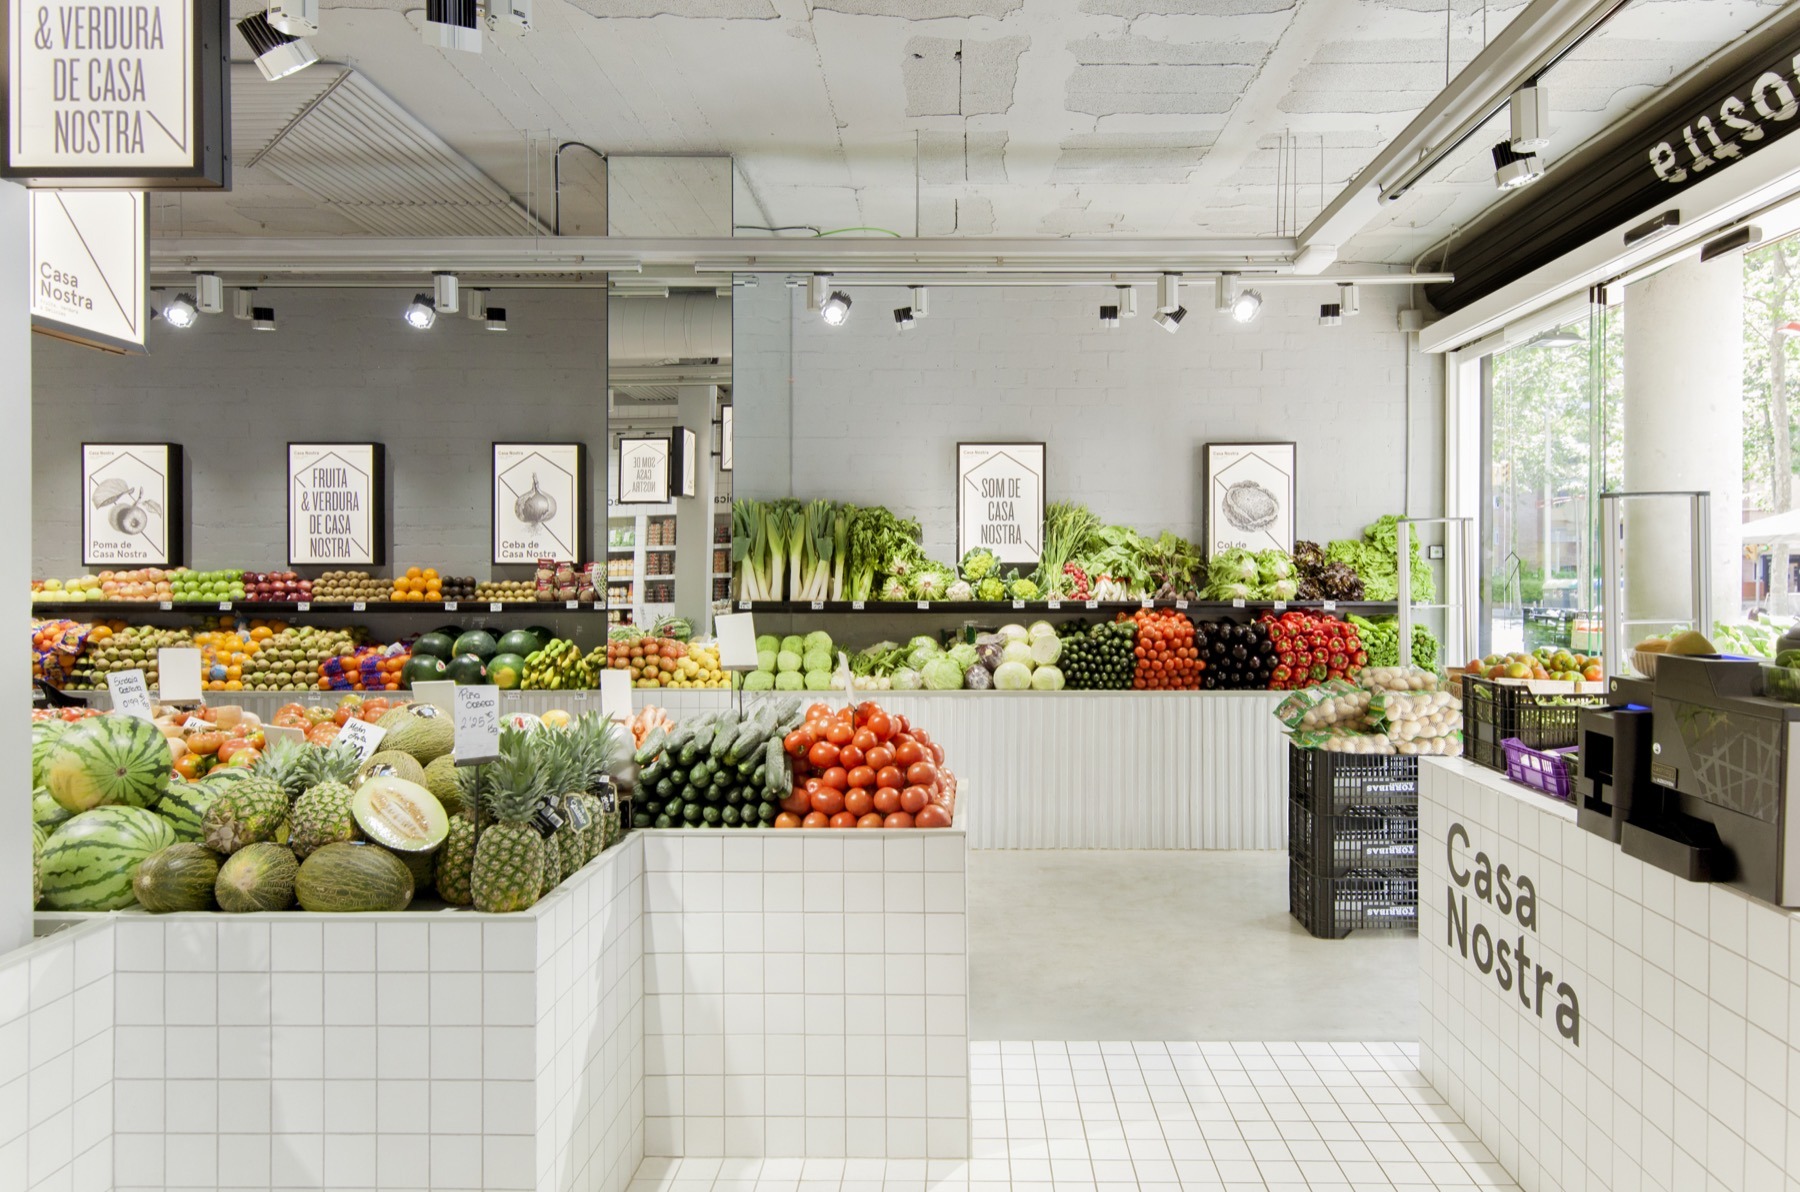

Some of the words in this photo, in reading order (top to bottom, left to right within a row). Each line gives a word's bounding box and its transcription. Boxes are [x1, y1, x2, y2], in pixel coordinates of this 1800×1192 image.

[35, 6, 53, 50] &
[59, 6, 164, 50] VERDURA
[53, 58, 80, 101] DE
[88, 58, 146, 101] CASA
[1649, 54, 1800, 183] ostra
[55, 110, 145, 153] NOSTRA
[40, 262, 78, 288] Casa
[40, 279, 93, 310] Nostra
[313, 468, 348, 488] FRUITA
[981, 478, 1005, 498] SOM
[1008, 478, 1021, 498] DE
[301, 491, 310, 511] &
[312, 491, 360, 511] VERDURA
[988, 501, 1015, 521] CASA
[309, 514, 322, 534] DE
[325, 514, 351, 534] CASA
[981, 524, 1022, 544] NOSTRA
[93, 541, 118, 549] Poma
[120, 541, 132, 549] de
[93, 550, 115, 558] Casa
[117, 550, 147, 558] Nostra
[310, 538, 351, 557] NOSTRA
[502, 541, 526, 549] Ceba
[528, 541, 539, 549] de
[502, 550, 524, 558] Casa
[526, 550, 557, 558] Nostra
[1217, 541, 1233, 549] Col
[1235, 541, 1247, 549] de
[1366, 782, 1415, 792] TORRIBAS
[1366, 845, 1415, 855] TORRIBAS
[1447, 822, 1537, 933] Casa
[1367, 906, 1415, 916] TORRIBAS
[1447, 885, 1580, 1048] Nostra
